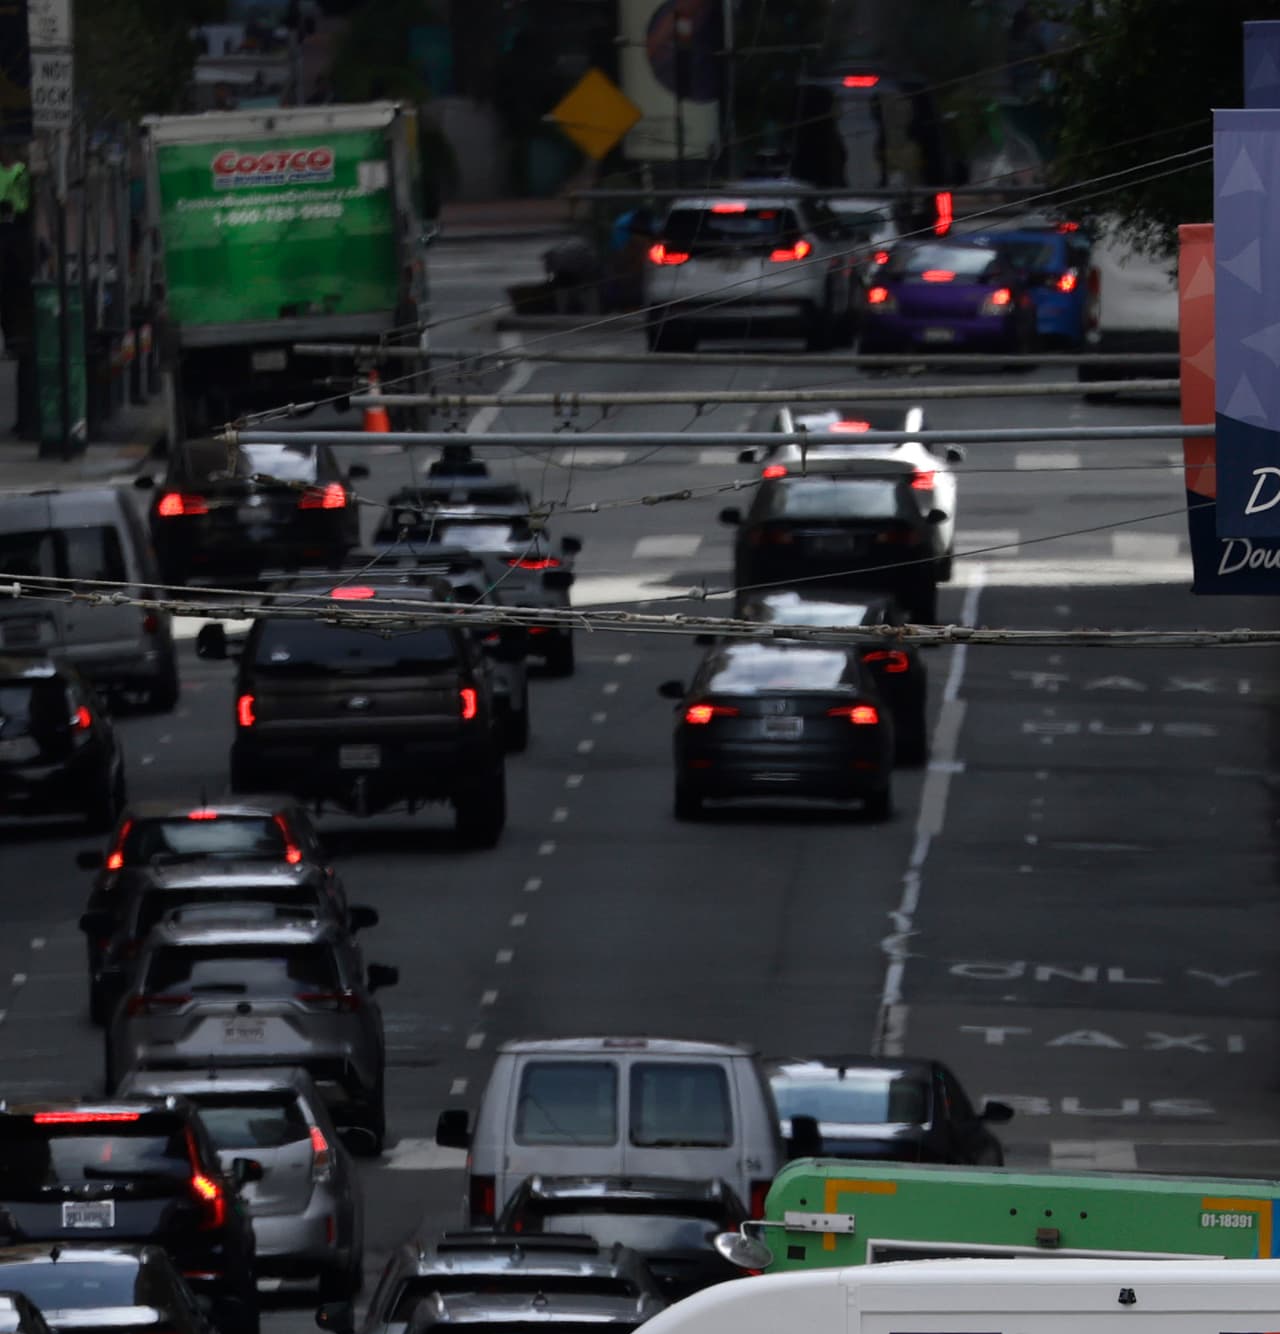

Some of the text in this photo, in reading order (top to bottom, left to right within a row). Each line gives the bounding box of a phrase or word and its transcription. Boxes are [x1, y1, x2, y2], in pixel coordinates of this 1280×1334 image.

[213, 149, 333, 175] COSTCO
[1008, 670, 1252, 694] TAXI
[947, 959, 1262, 988] ONLY
[959, 1024, 1246, 1055] TAXI
[1200, 1212, 1253, 1229] 01-18391
